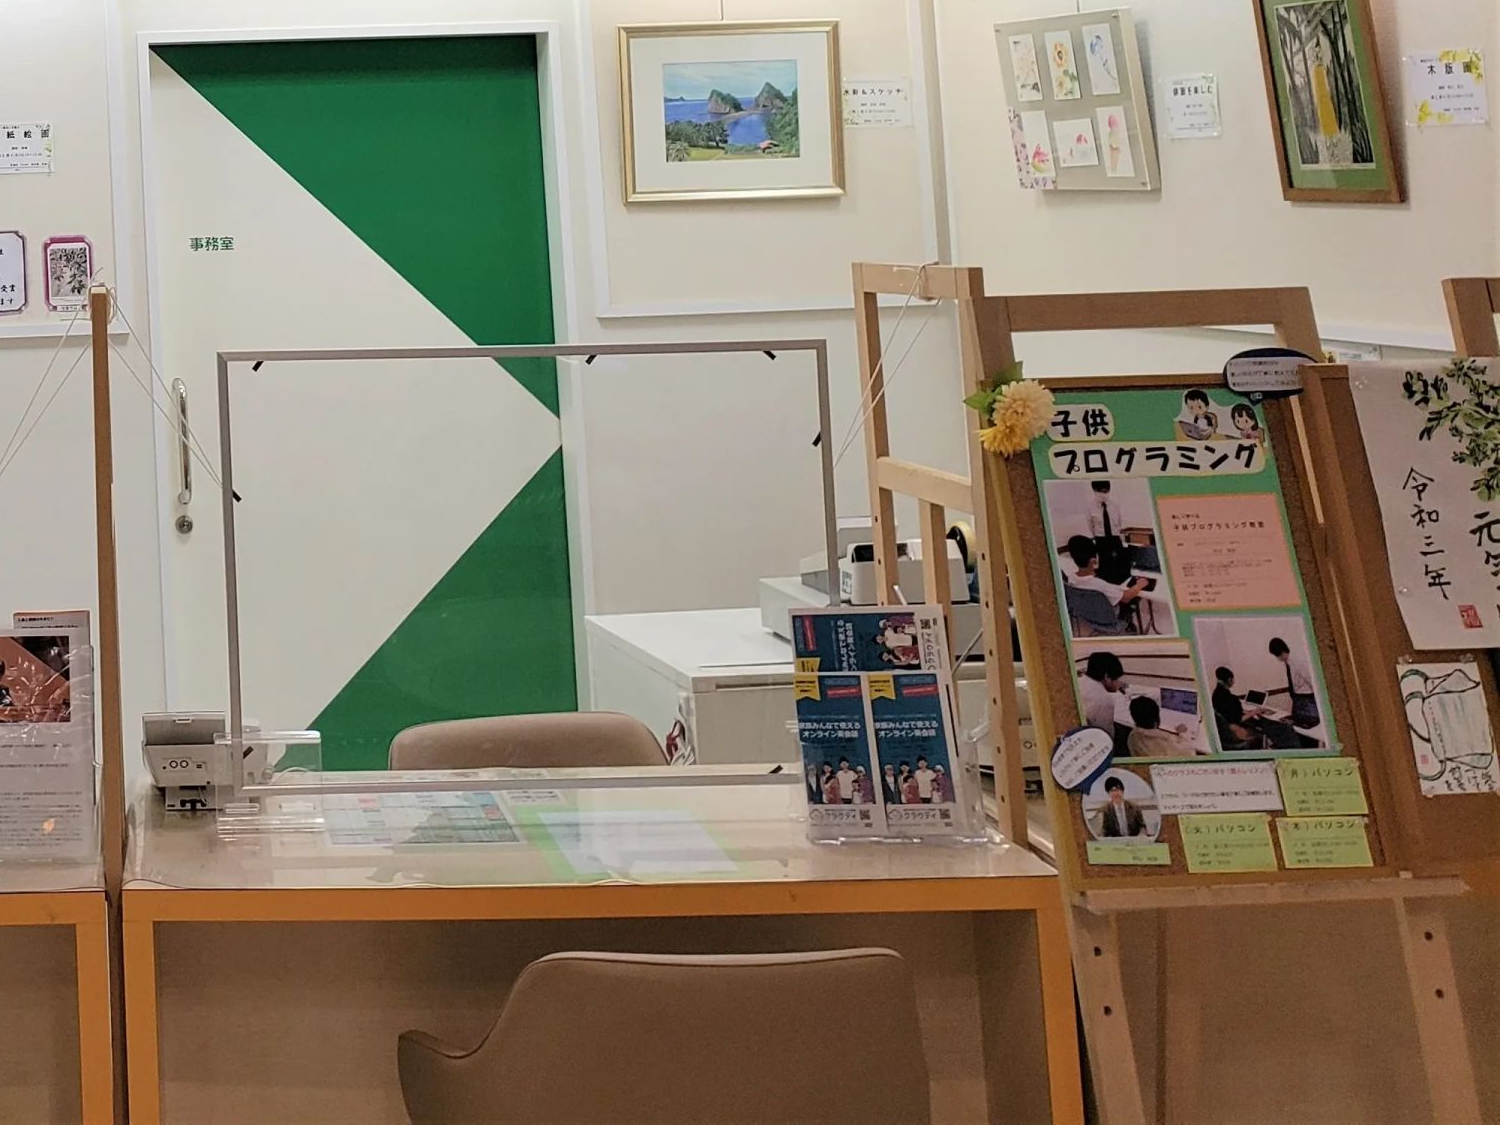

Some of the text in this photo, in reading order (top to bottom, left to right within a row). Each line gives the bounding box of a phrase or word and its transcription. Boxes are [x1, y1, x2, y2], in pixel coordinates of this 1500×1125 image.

[189, 236, 235, 252] 事務室
[1051, 408, 1111, 437] 子供
[1053, 443, 1259, 475] プログラミング
[1402, 466, 1452, 601] 令和三年
